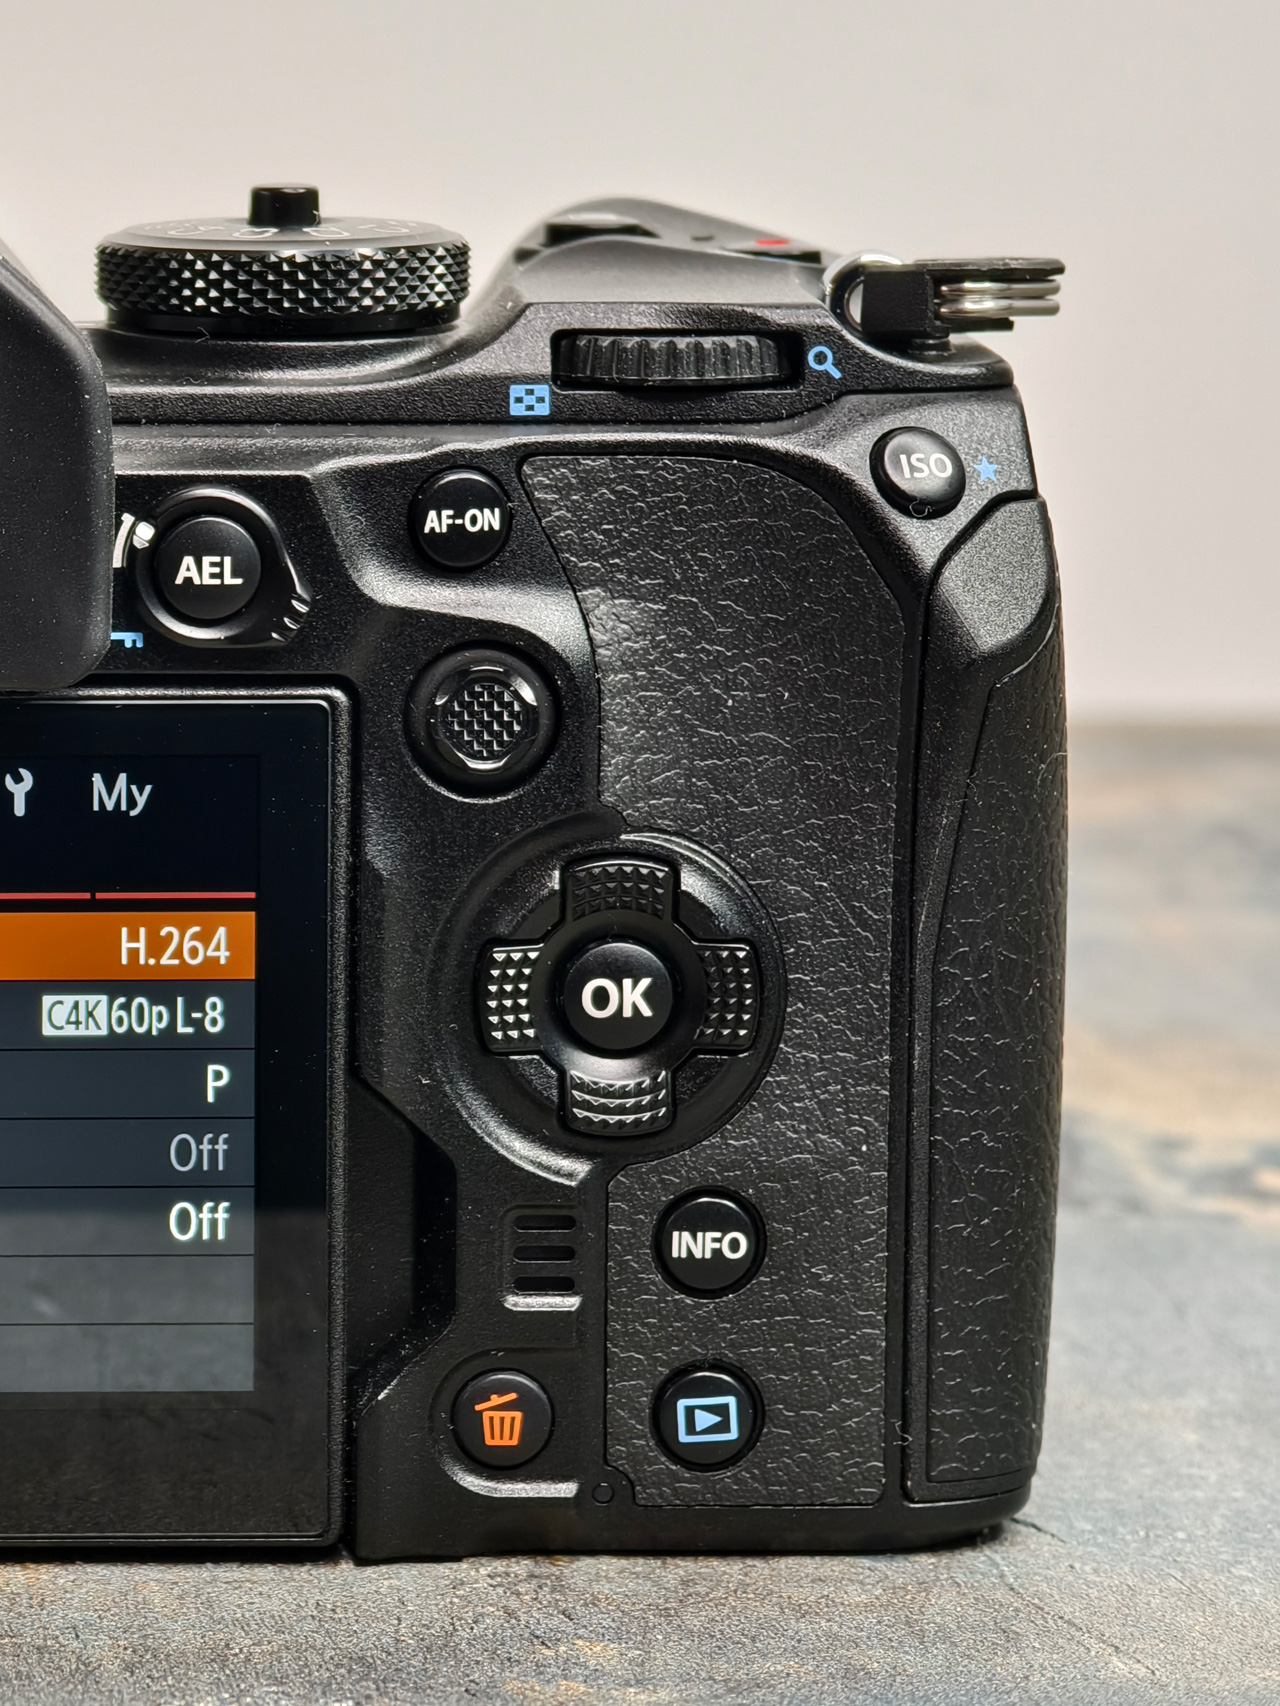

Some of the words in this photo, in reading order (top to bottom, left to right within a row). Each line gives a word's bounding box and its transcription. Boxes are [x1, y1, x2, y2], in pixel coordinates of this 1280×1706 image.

[899, 452, 953, 479] ISO
[423, 507, 501, 534] AF-ON
[174, 555, 244, 585] AEL
[92, 772, 153, 817] My
[121, 926, 231, 965] H.264
[581, 977, 654, 1019] OK
[206, 1064, 231, 1103] P
[170, 1133, 230, 1172] Off
[169, 1201, 231, 1241] Off
[671, 1230, 748, 1260] INFO
